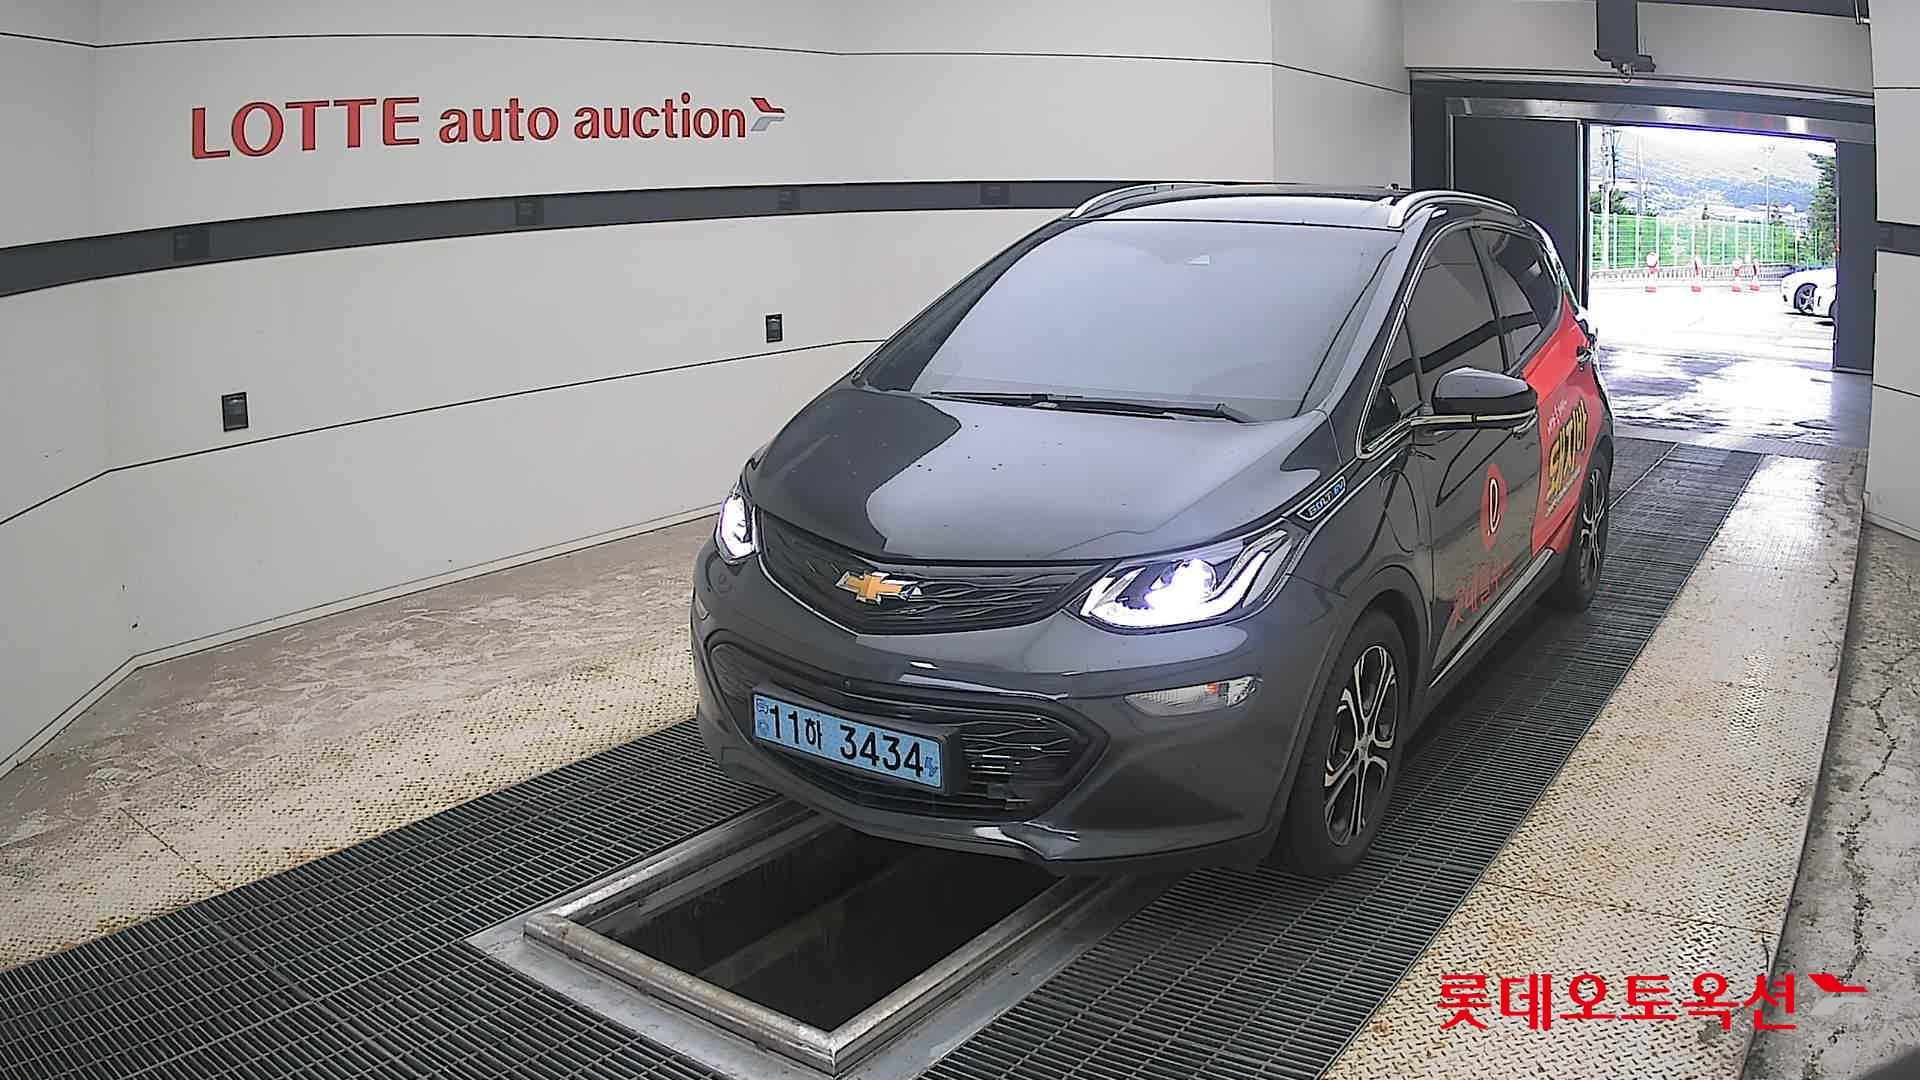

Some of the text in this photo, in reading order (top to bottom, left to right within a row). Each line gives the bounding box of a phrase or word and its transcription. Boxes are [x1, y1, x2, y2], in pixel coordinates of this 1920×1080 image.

[191, 91, 747, 160] LOTTE auto auction
[769, 704, 924, 777] 11하 3434
